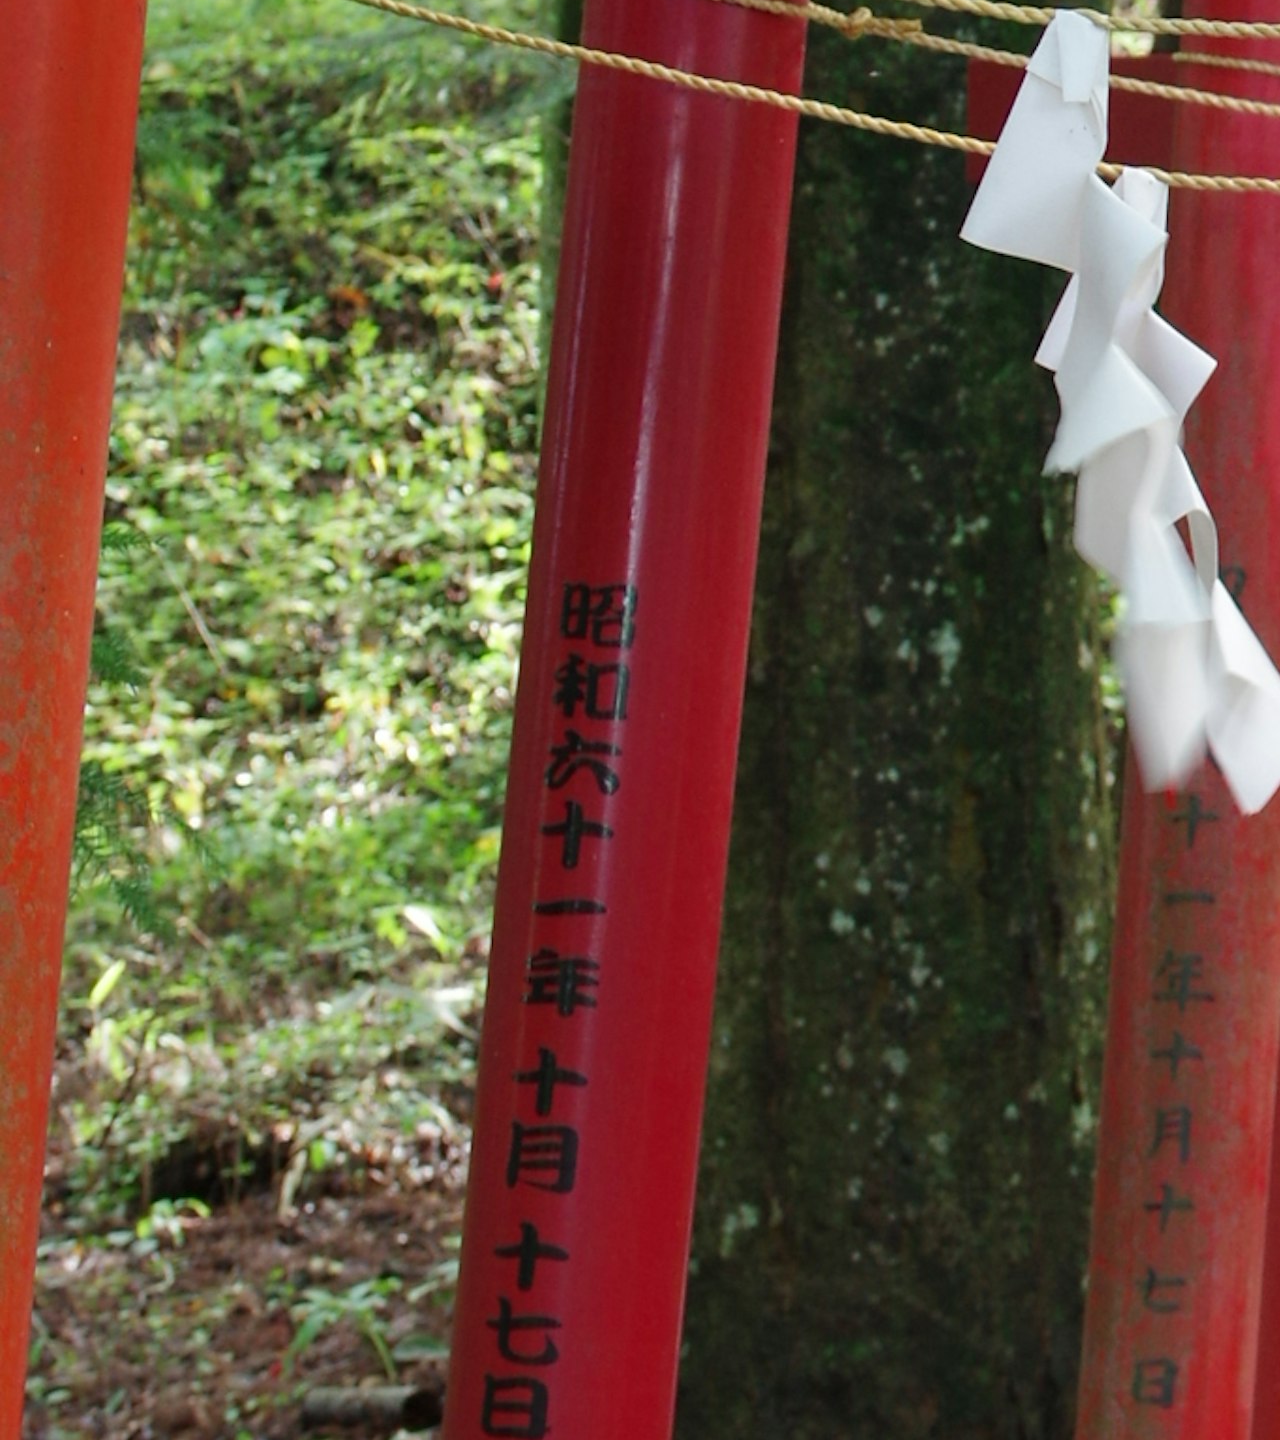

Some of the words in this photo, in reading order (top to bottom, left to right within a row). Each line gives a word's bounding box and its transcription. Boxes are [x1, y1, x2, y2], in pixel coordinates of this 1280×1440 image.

[1130, 565, 1247, 1410] 十一年十月十七日
